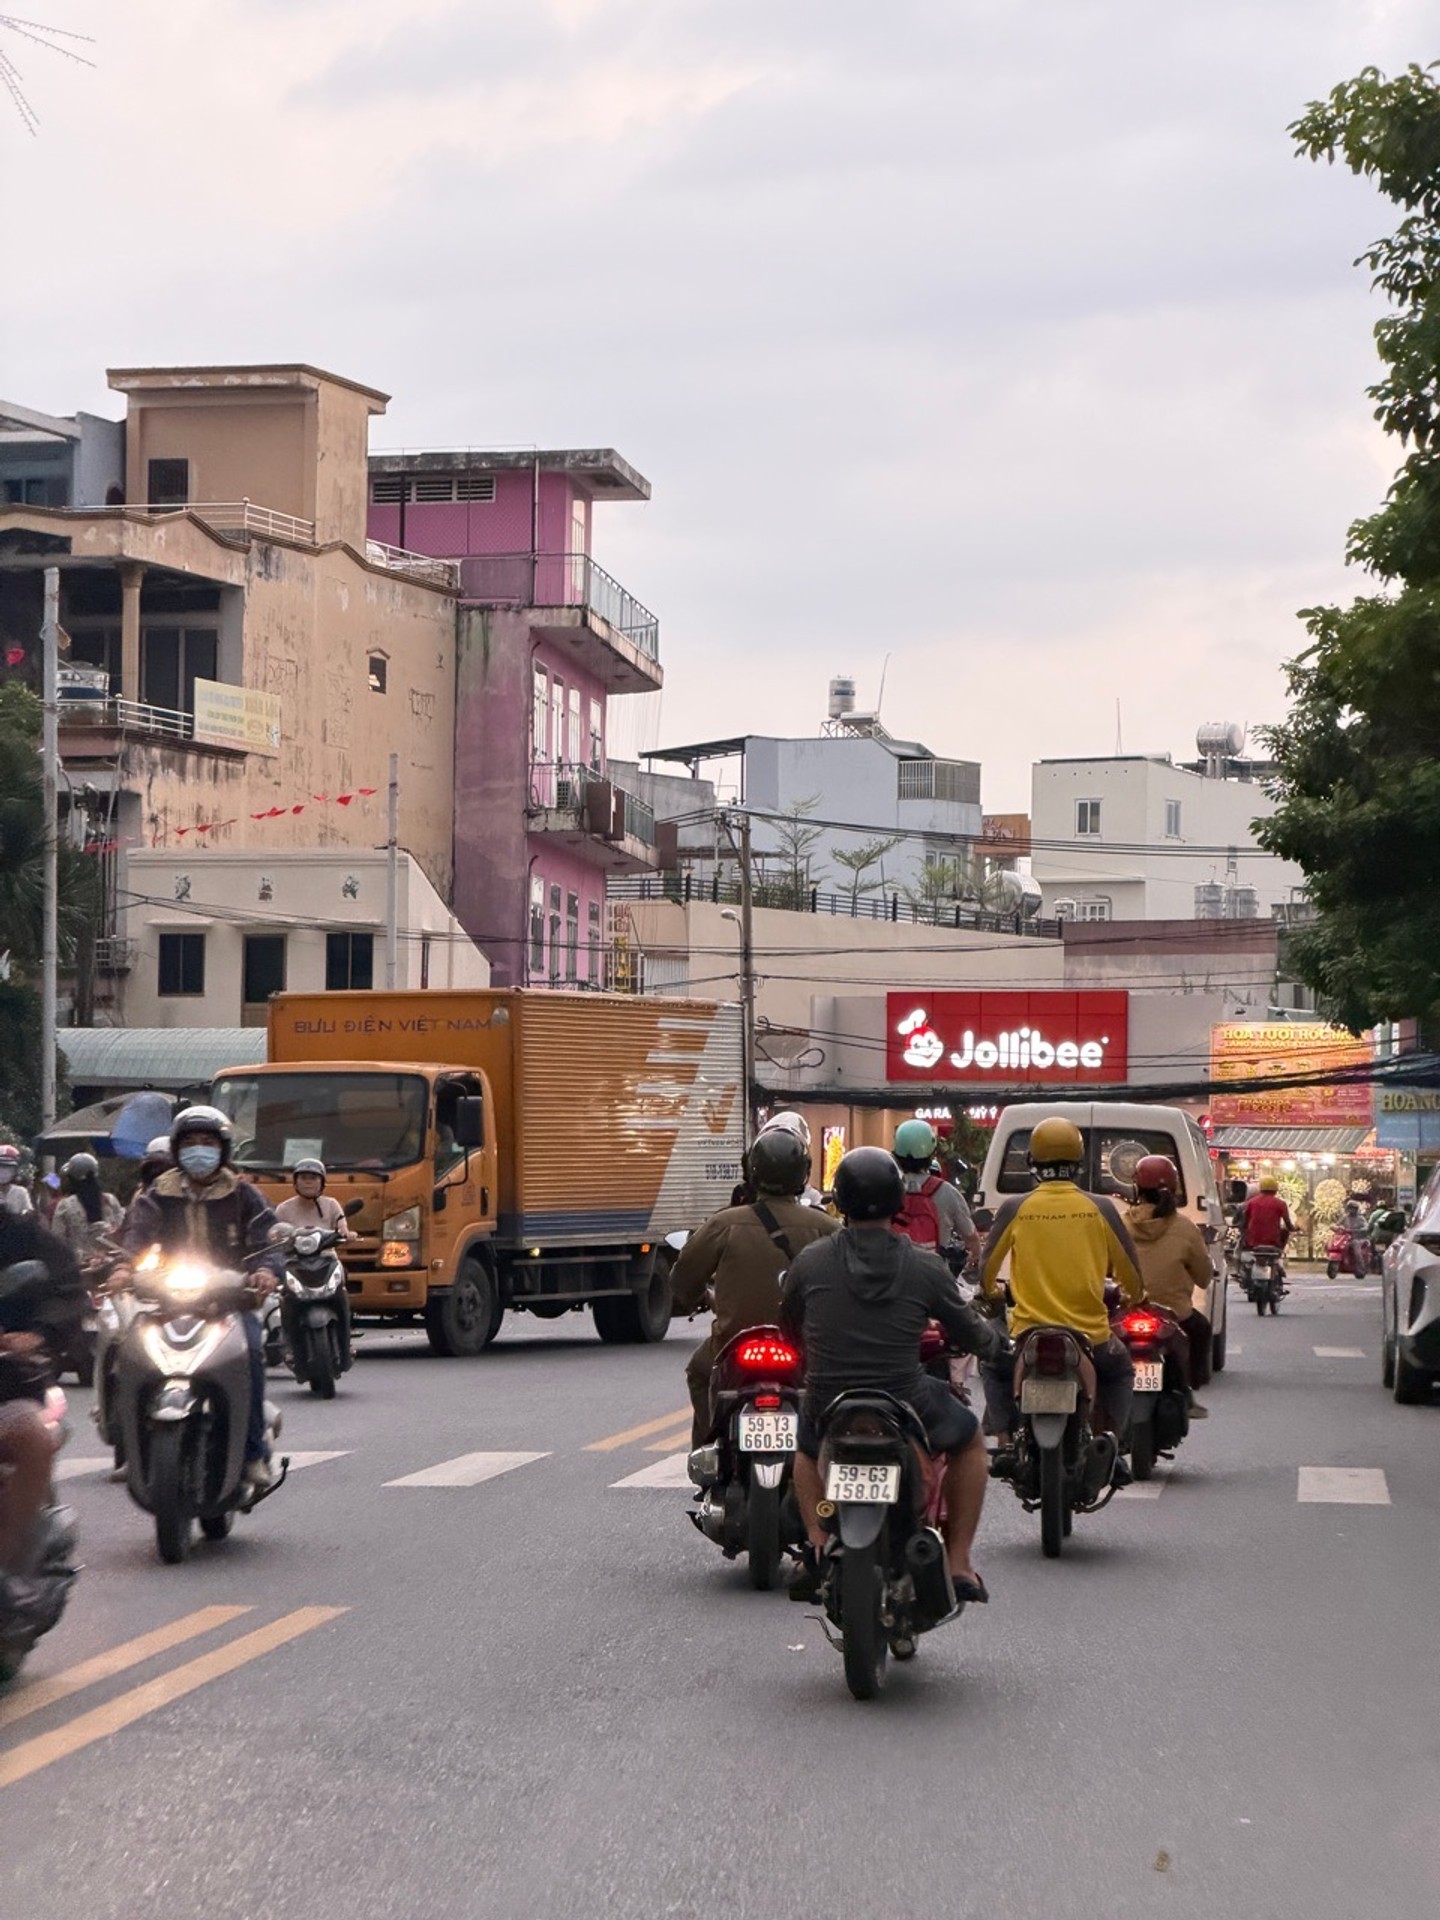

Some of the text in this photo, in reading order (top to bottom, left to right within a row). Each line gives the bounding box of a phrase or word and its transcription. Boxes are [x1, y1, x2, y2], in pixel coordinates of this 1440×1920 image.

[344, 1015, 392, 1036] ĐIỆN
[399, 1015, 438, 1035] VIỆT
[447, 1018, 491, 1032] NAM
[951, 1028, 1103, 1068] Jollibee
[1018, 1213, 1066, 1221] VIETNAM
[748, 1417, 790, 1432] 59-Y3
[744, 1434, 794, 1449] 660.56
[838, 1466, 888, 1483] 59-G3
[834, 1484, 891, 1500] 158.04
